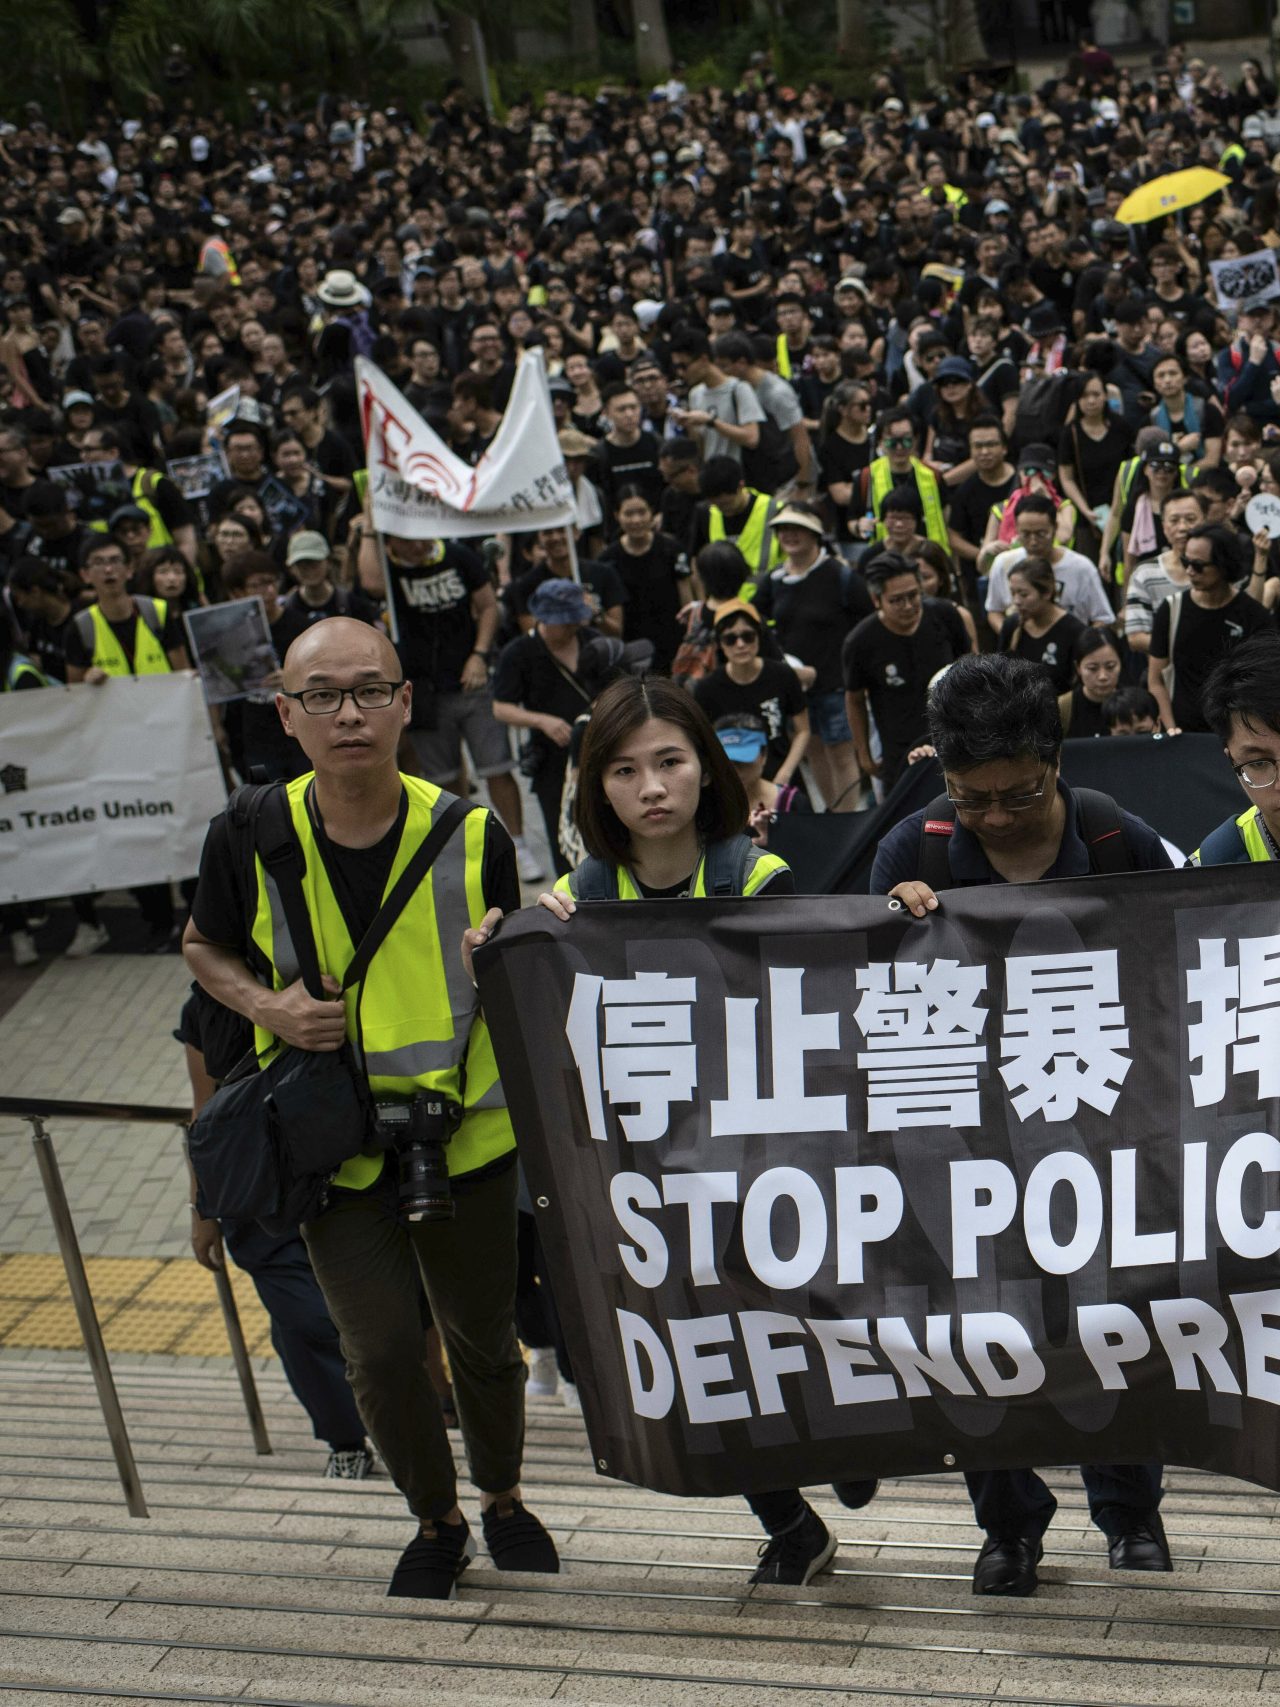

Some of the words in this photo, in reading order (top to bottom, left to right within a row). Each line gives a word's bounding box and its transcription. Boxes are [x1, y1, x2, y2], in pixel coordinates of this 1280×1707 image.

[400, 568, 466, 607] VANS
[20, 804, 97, 829] Trade
[103, 799, 174, 820] Union
[565, 949, 1133, 1142] 停止警暴
[610, 1165, 904, 1290] STOP
[616, 1307, 1046, 1424] DEFEND
